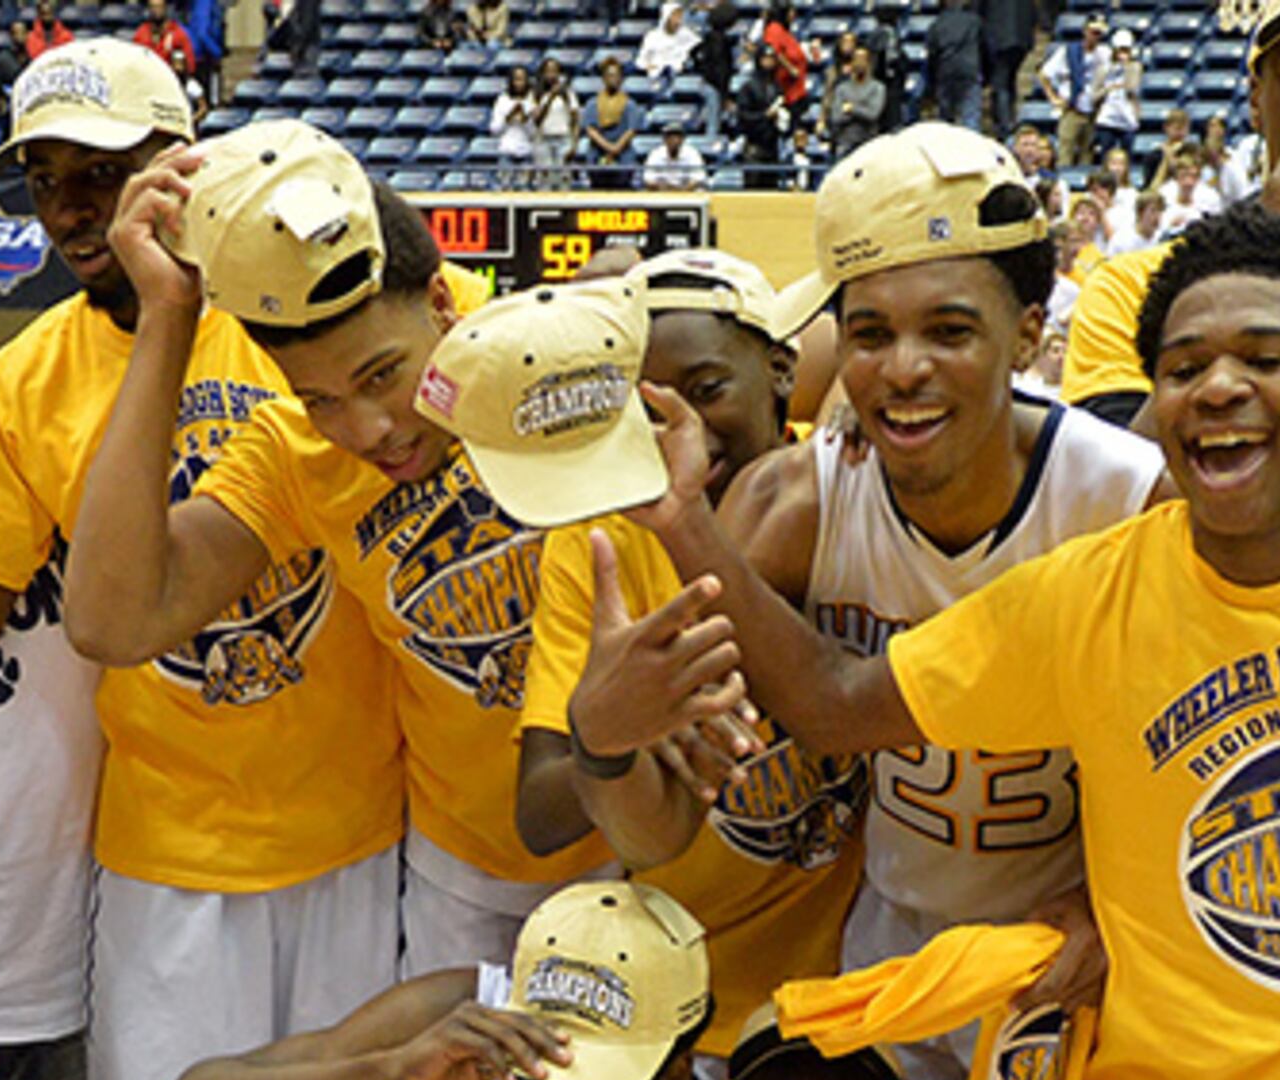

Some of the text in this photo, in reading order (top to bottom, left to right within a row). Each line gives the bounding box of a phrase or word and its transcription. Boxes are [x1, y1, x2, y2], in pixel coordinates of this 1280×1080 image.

[542, 234, 592, 278] 59
[1143, 652, 1276, 765] WHEELER
[871, 746, 1081, 853] 23
